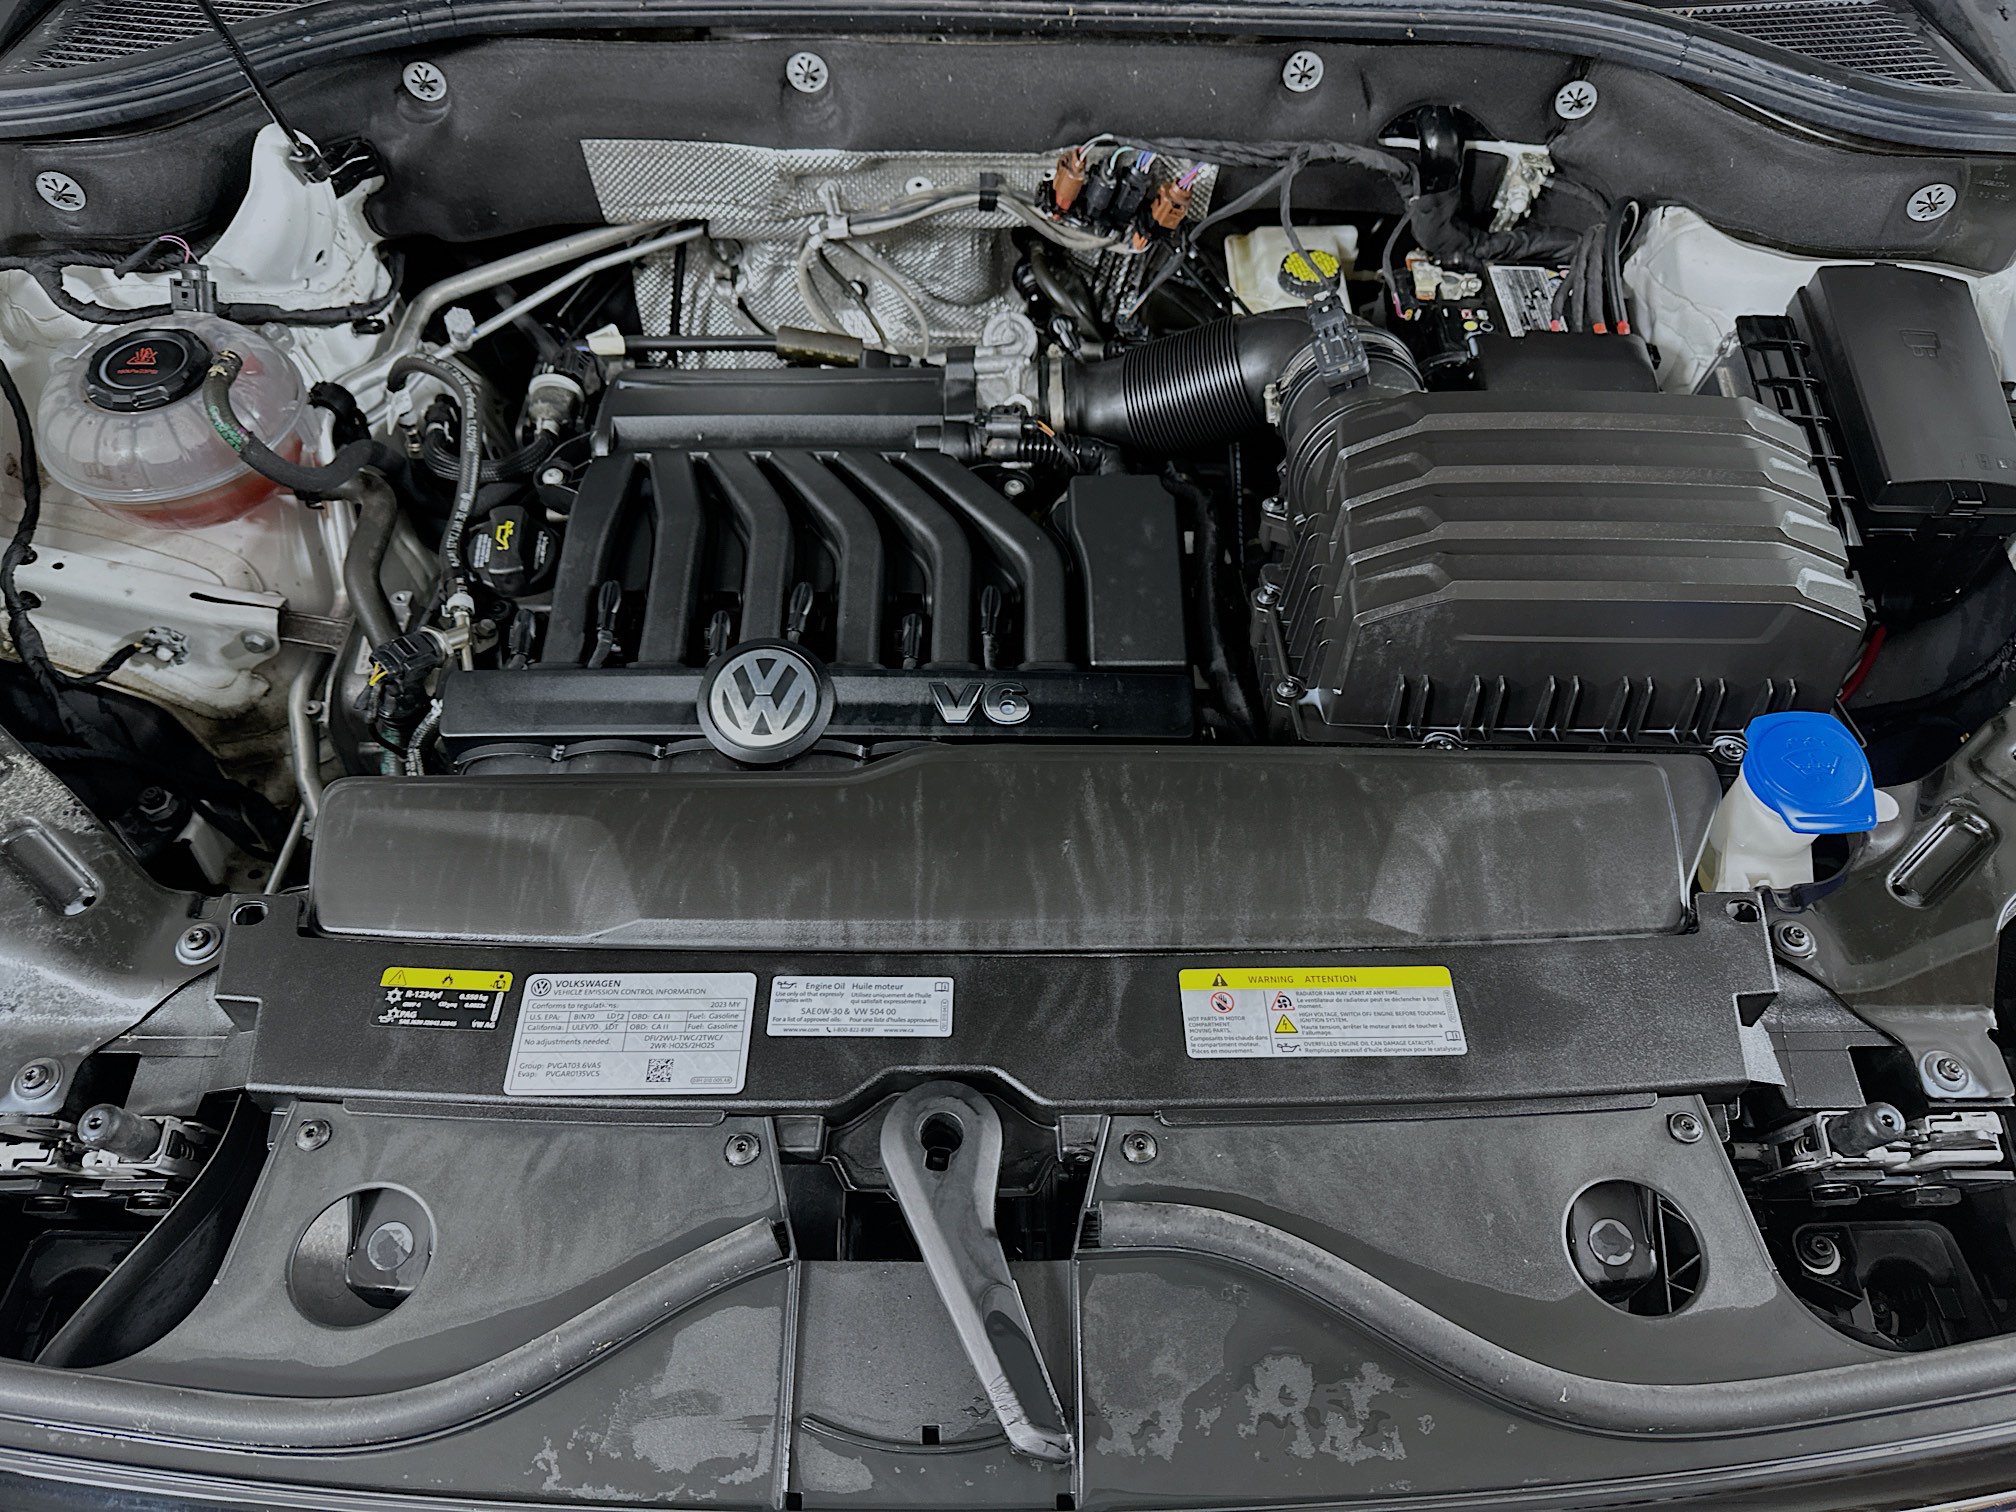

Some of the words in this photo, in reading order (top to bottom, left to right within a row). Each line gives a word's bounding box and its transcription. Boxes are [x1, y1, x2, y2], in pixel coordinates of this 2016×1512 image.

[929, 681, 1031, 725] V6
[1248, 976, 1294, 984] WARNING
[1305, 974, 1357, 982] ATTENTION
[555, 980, 621, 988] VOLKSWAGEN
[806, 982, 832, 991] Engine
[405, 990, 444, 1000] R-1234yf
[400, 1010, 418, 1018] PAG
[536, 1038, 581, 1046] adjustments
